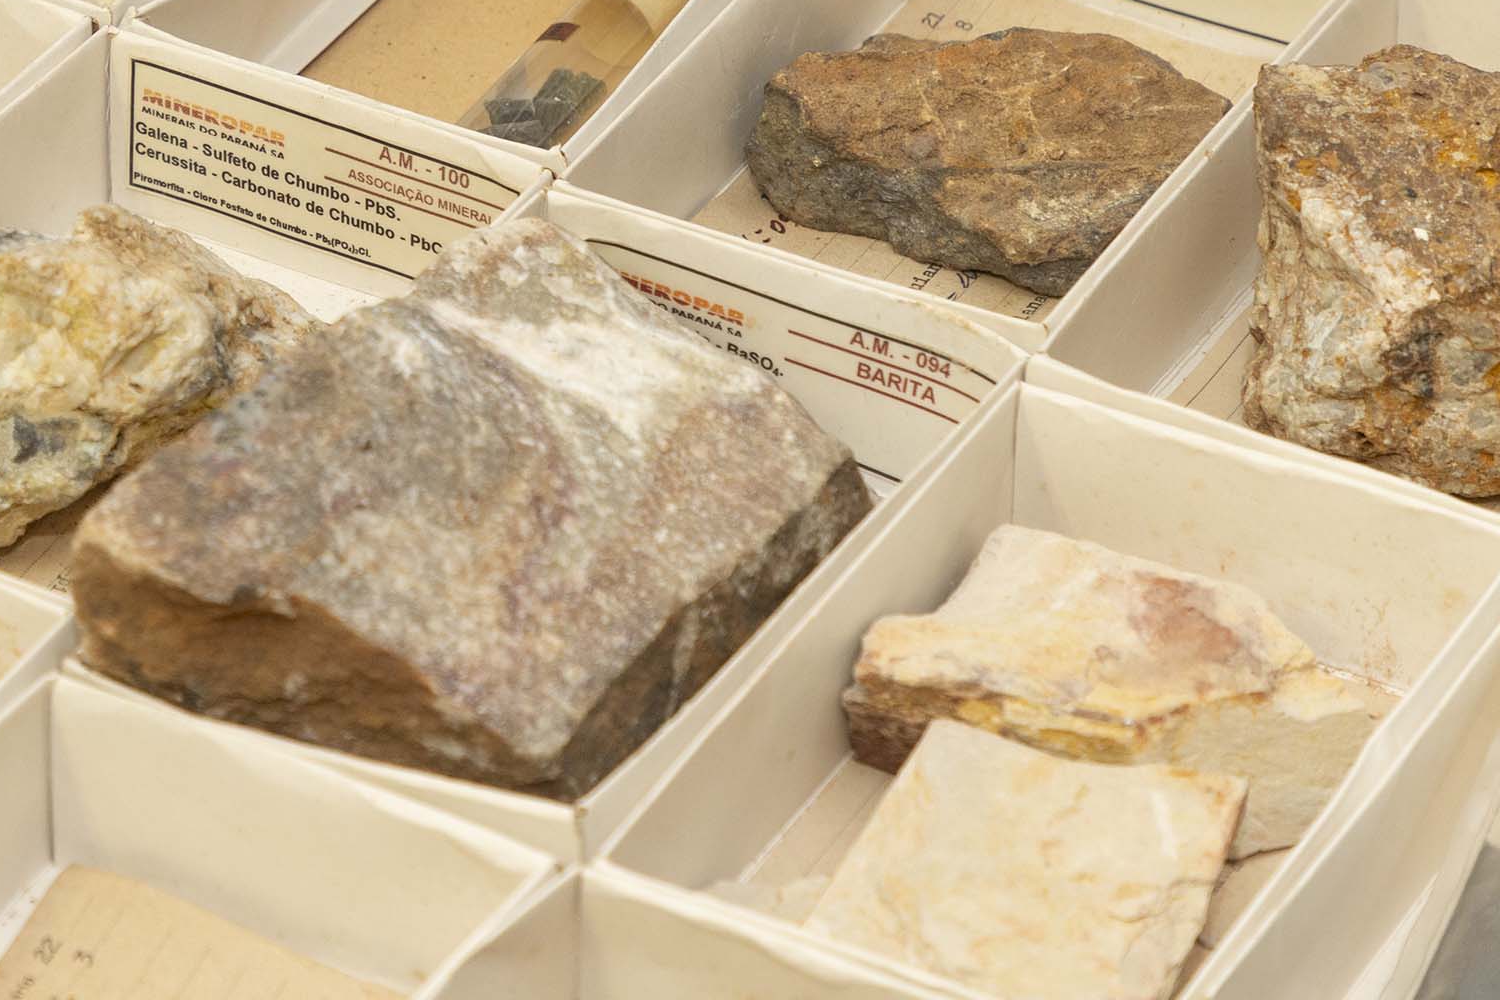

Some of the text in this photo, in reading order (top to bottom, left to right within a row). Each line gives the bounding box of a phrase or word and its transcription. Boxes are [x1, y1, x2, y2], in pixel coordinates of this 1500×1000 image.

[142, 88, 284, 148] MINEROPAR
[142, 105, 285, 160] MINERAIS DO PARANÁ SA
[135, 142, 207, 176] Cerussita
[222, 171, 301, 208] Carbonato
[306, 201, 324, 216] de
[329, 208, 395, 239] Chumbo
[136, 121, 188, 149] Galena
[202, 143, 256, 172] Sulfeto
[261, 164, 279, 180] de
[284, 171, 350, 204] Chumbo
[365, 197, 401, 222] PbS.
[348, 168, 434, 206] ASSOCIAÇÃO
[379, 146, 418, 173] A.M.
[438, 166, 470, 189] 100
[134, 171, 185, 194] Piromorfita
[193, 189, 218, 205] Cloro
[220, 199, 254, 217] Fosfato
[256, 212, 268, 223] de
[269, 217, 307, 236] Chumbo
[620, 271, 745, 326] NEROPAR
[671, 307, 723, 331] PARANÁ
[727, 327, 743, 338] SA
[850, 331, 894, 358] A.M.
[916, 351, 951, 378] 094
[856, 361, 936, 404] BARITA
